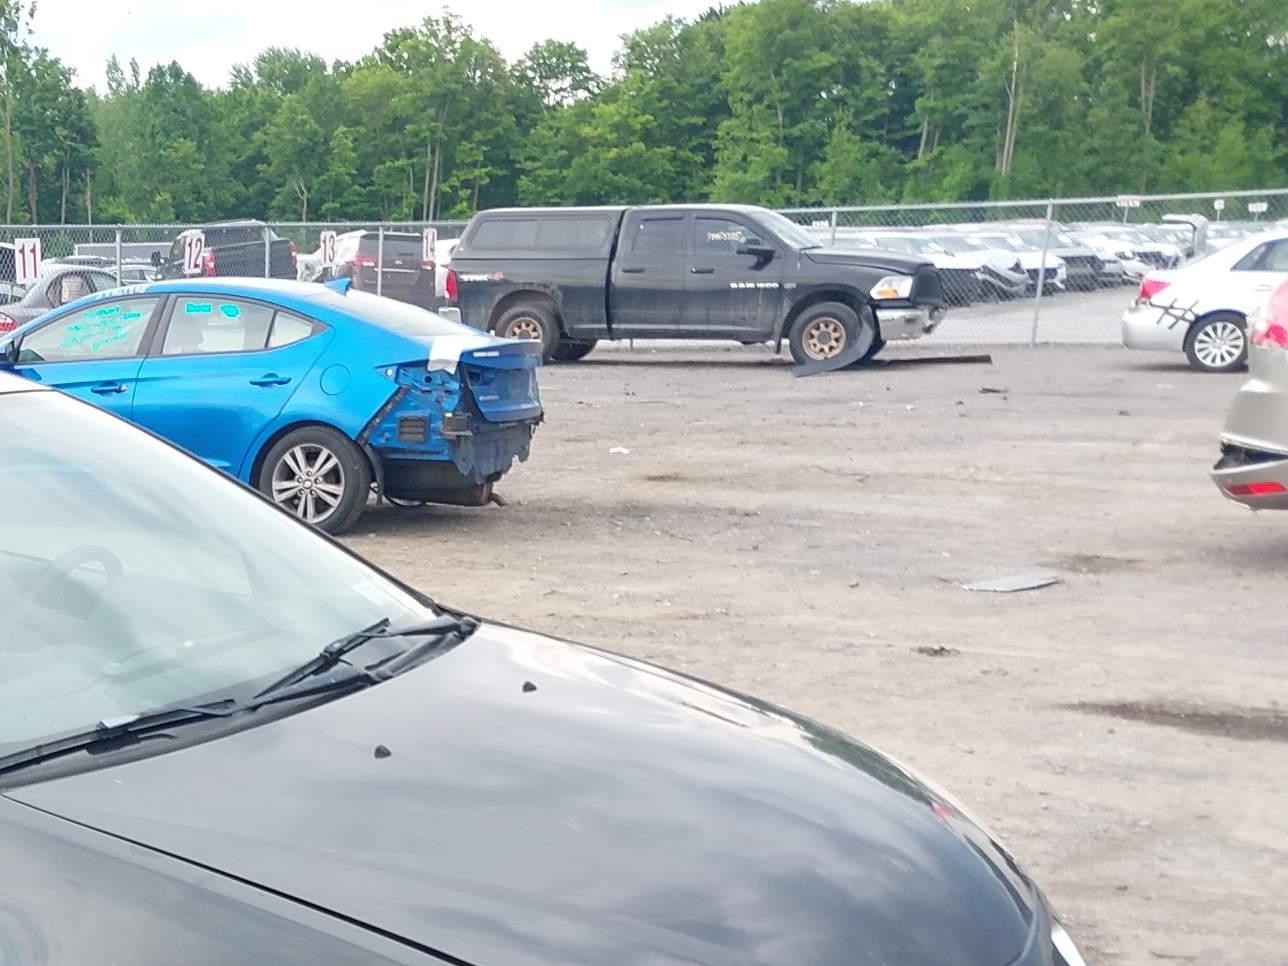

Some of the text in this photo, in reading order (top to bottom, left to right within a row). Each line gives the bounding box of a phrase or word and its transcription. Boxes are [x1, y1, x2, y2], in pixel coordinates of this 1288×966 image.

[18, 242, 38, 279] 11
[187, 237, 203, 270] 12
[322, 234, 336, 264] 13
